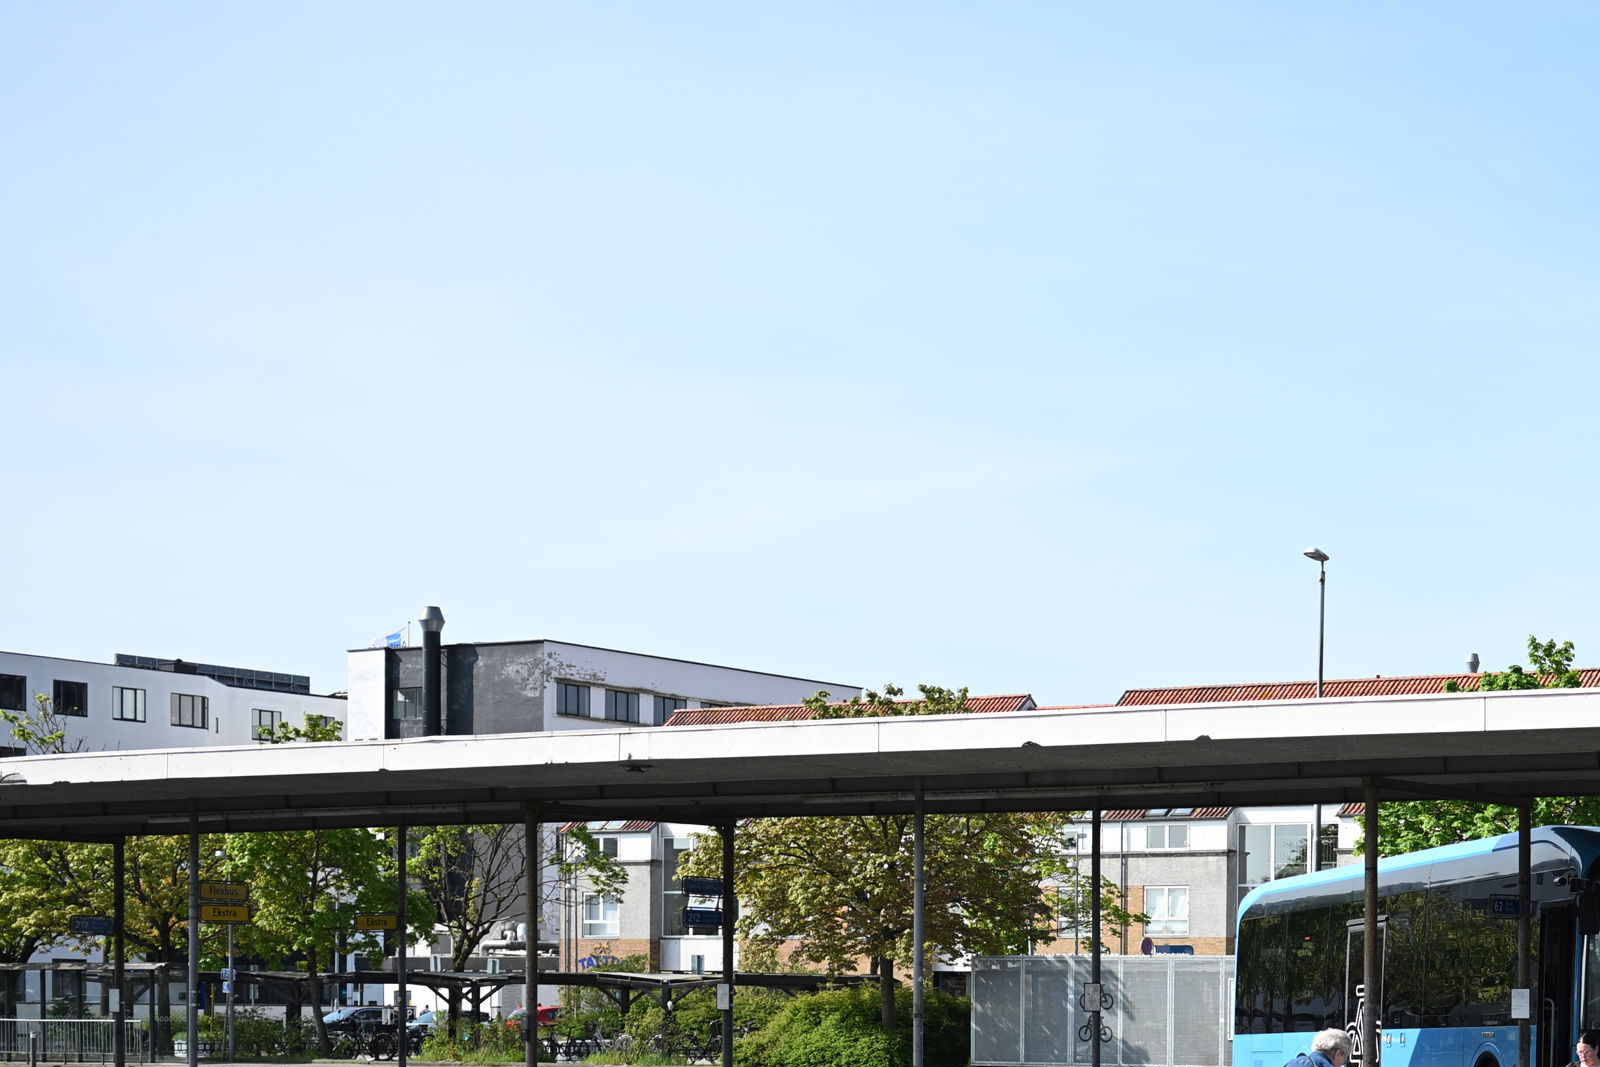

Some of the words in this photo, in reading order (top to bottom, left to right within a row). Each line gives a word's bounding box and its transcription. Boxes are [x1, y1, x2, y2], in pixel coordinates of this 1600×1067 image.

[209, 886, 239, 896] Flexbus
[1494, 901, 1504, 912] 62
[212, 908, 237, 917] Ekstra
[366, 917, 388, 926] Ekstra
[687, 913, 701, 922] 212
